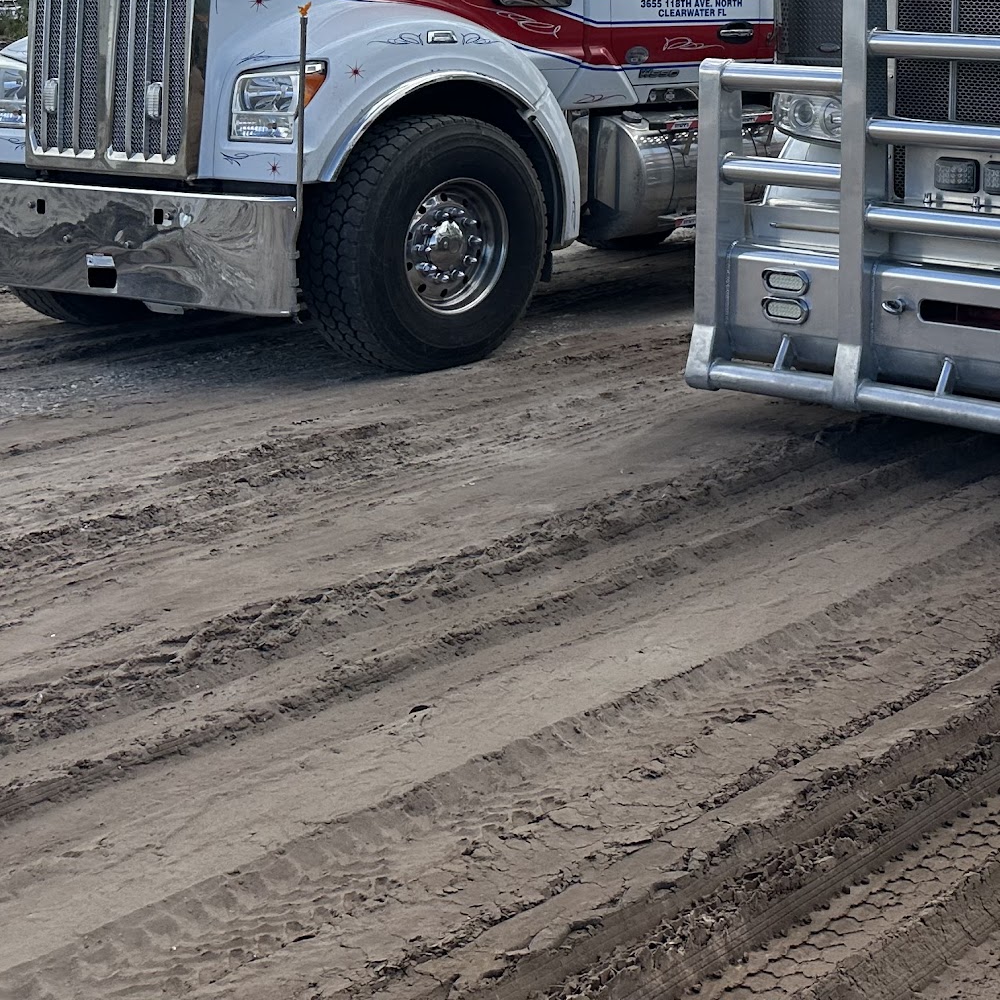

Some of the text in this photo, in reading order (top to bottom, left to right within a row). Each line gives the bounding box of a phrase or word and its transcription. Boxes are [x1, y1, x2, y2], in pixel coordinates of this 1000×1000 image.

[640, 0, 743, 8] 3655 118TH AVE. NORTH
[658, 8, 727, 18] CLEARWATER FL
